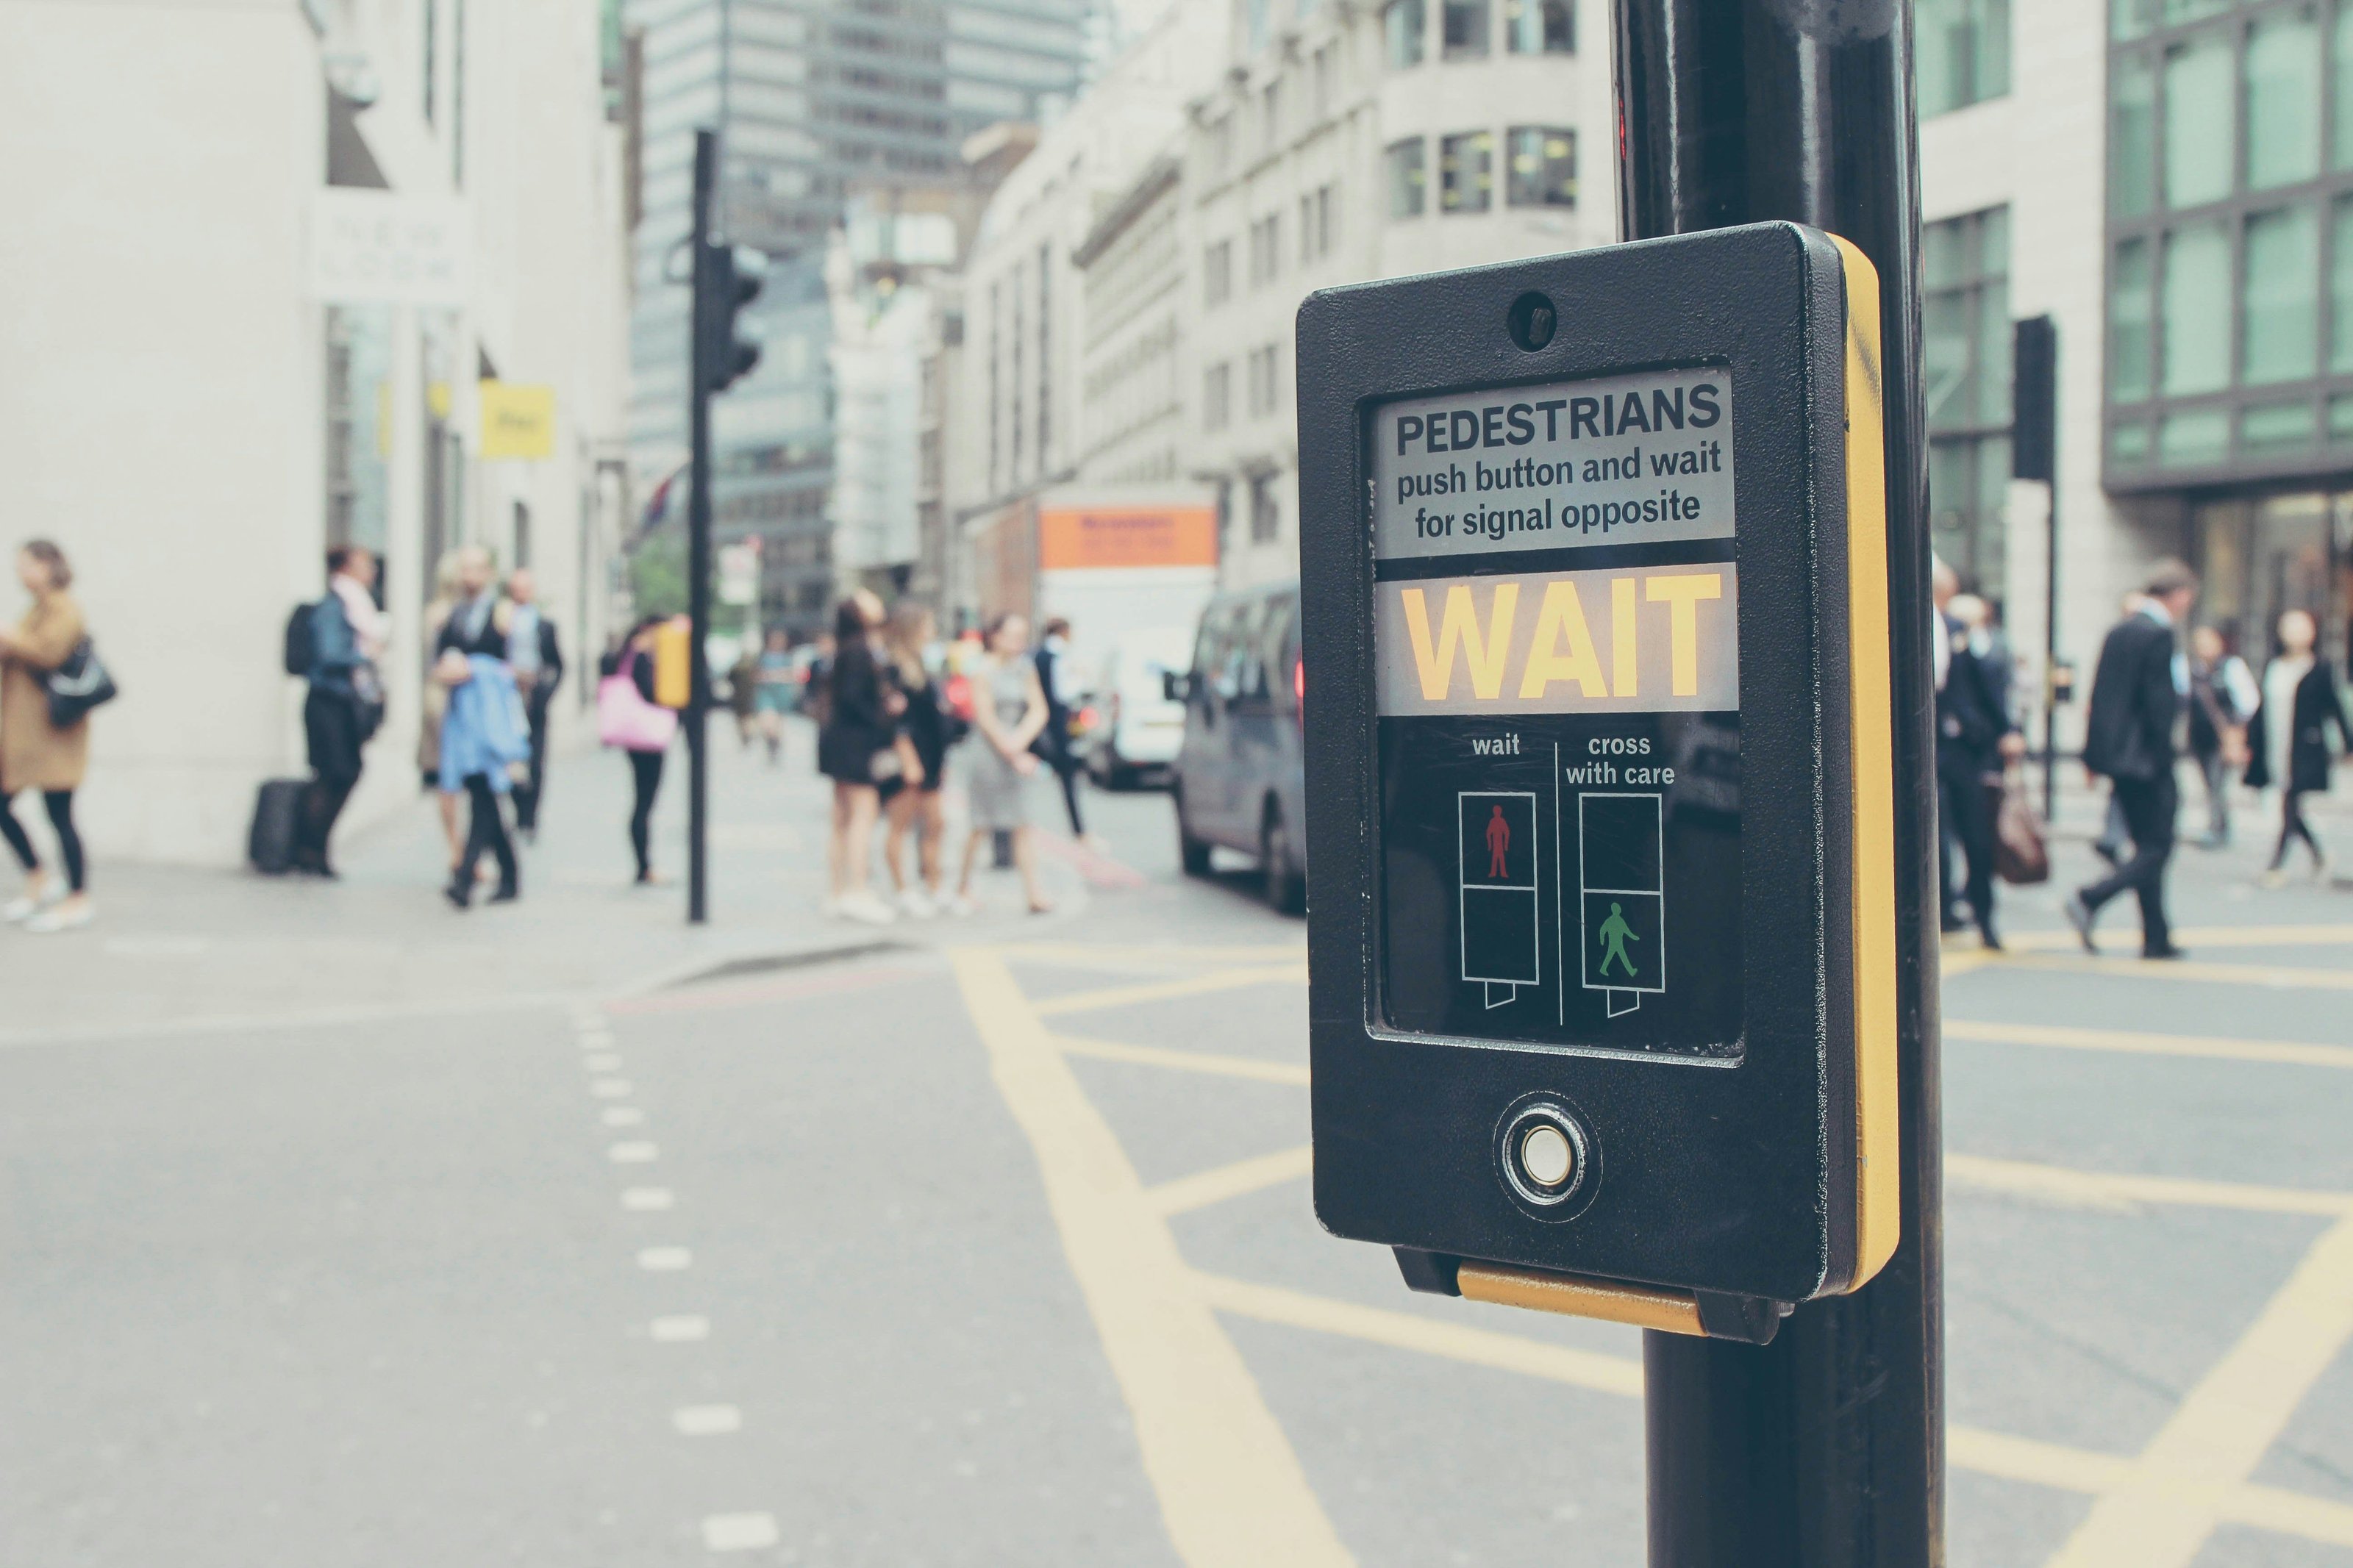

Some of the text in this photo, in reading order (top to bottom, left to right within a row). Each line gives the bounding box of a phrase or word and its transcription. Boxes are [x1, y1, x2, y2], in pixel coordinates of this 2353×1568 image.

[1397, 383, 1721, 457] PEDESTRIANS
[1398, 440, 1721, 505] push button and wait
[1415, 490, 1701, 541] for signal opposite
[1401, 573, 1721, 701] WAIT
[1472, 733, 1520, 756] wait
[1588, 735, 1652, 755] cross
[1566, 762, 1675, 784] with care
